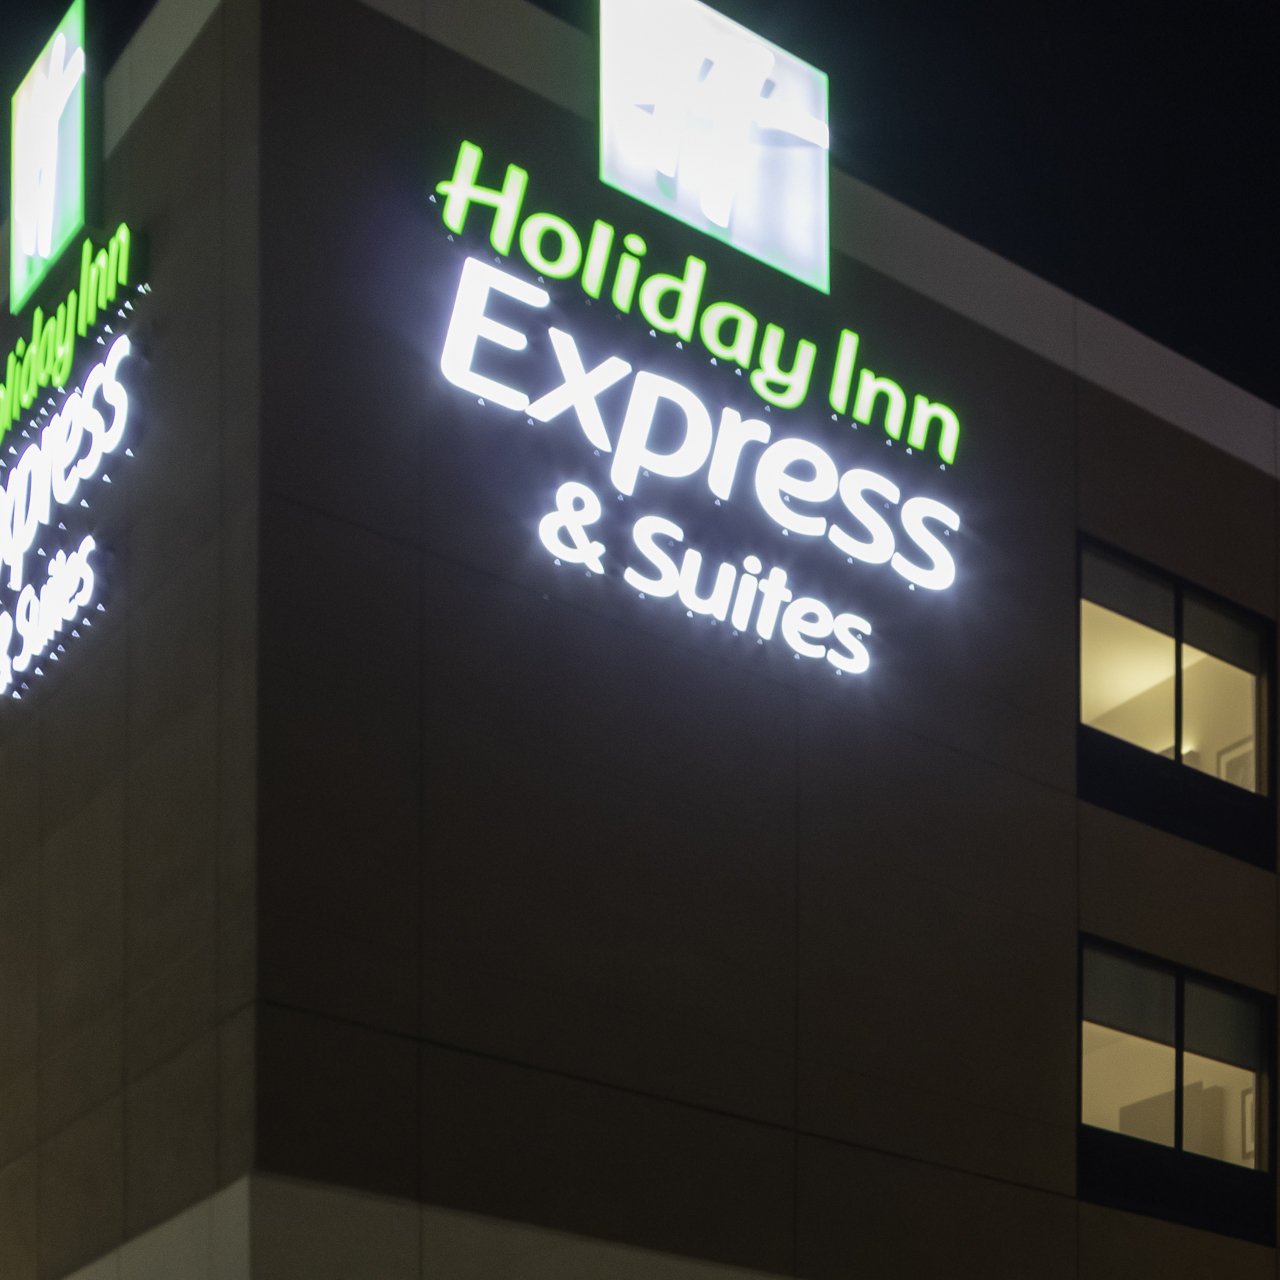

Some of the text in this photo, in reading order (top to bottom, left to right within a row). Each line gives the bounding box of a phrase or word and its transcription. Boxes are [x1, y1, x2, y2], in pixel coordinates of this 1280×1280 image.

[77, 222, 130, 337] Inn
[436, 140, 960, 465] Holiday Inn
[440, 256, 960, 591] Express
[538, 481, 871, 674] & Suites
